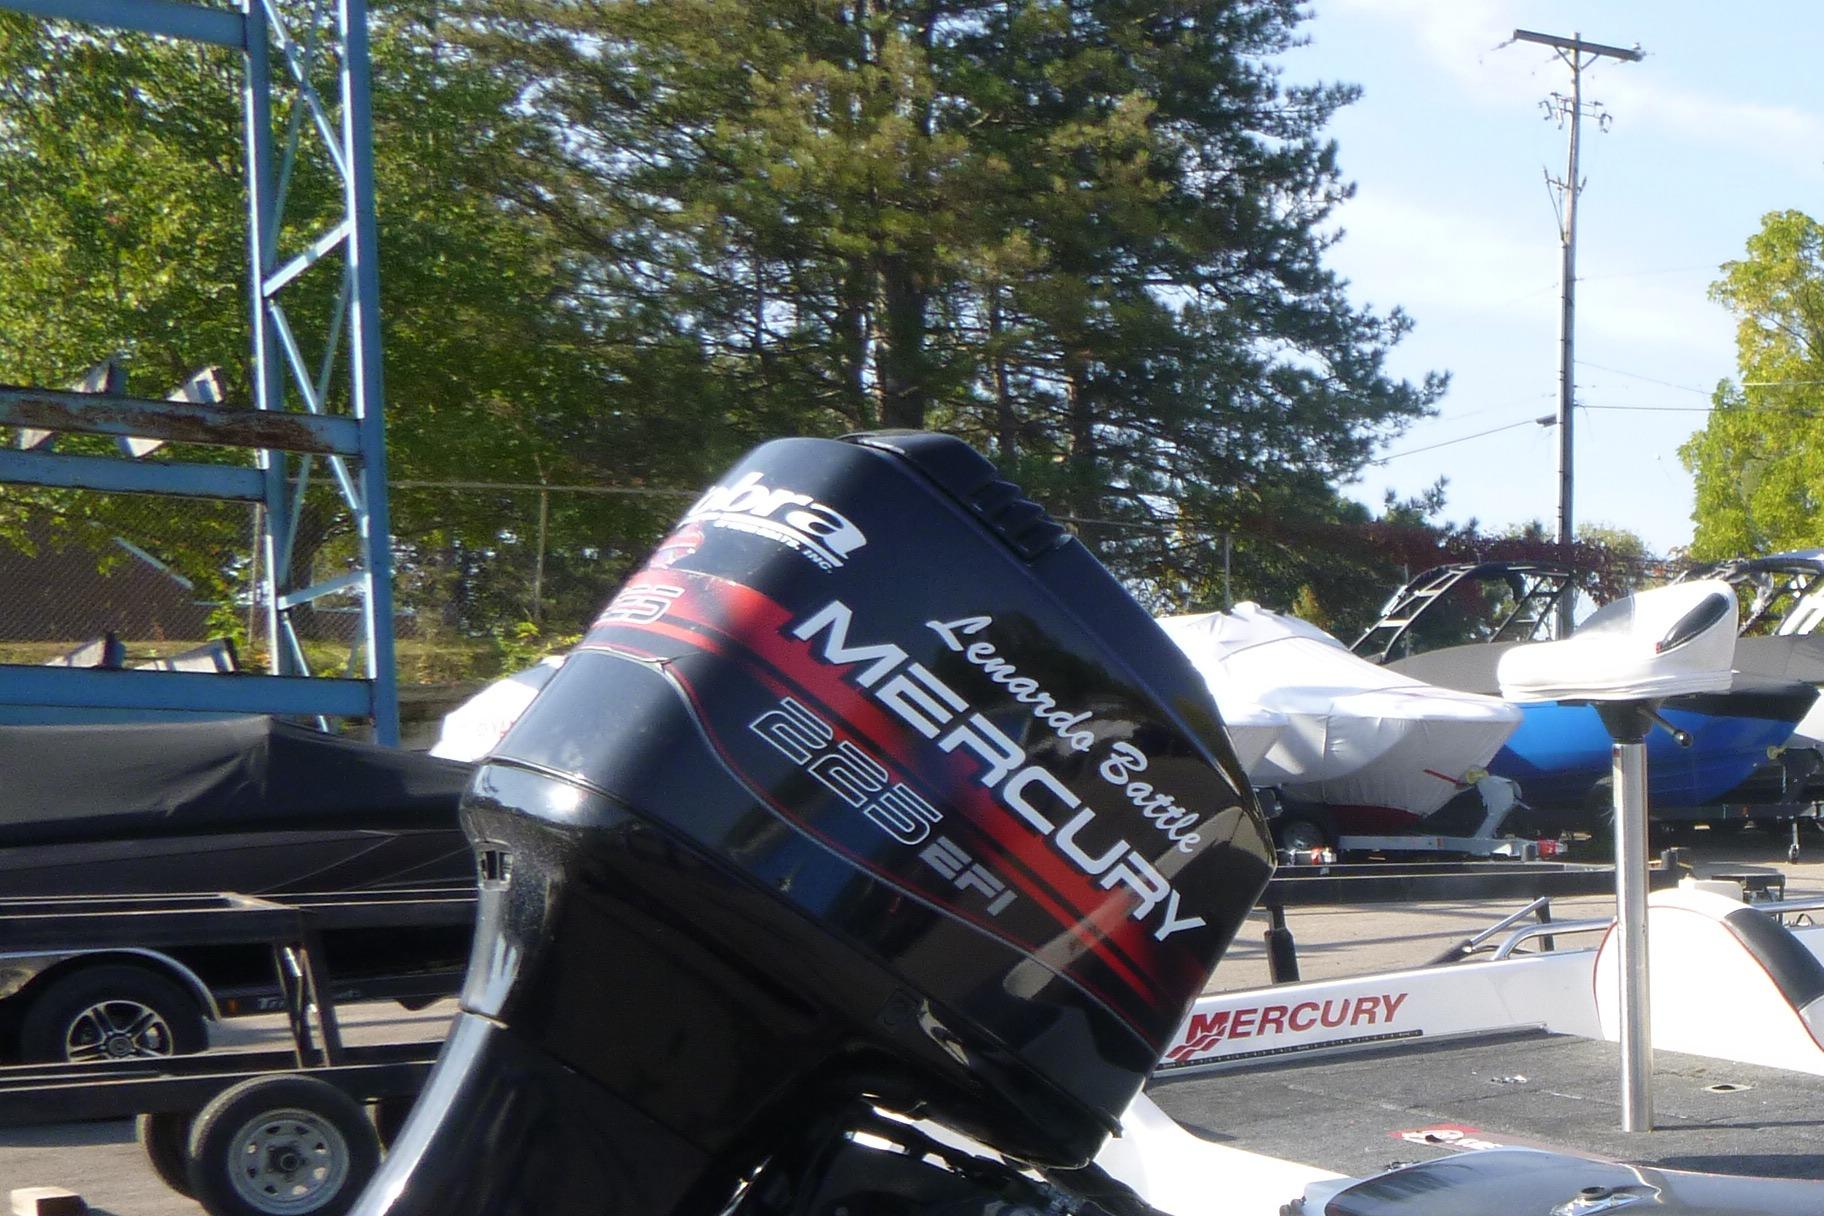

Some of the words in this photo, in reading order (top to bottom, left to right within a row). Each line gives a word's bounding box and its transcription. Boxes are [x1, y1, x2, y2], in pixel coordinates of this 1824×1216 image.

[749, 696, 943, 846] 225
[793, 600, 1206, 941] MERCURY
[925, 615, 1095, 752] Lenardo
[1099, 741, 1201, 853] Battle
[918, 836, 1018, 916] EFI
[1172, 993, 1408, 1058] MERCURY
